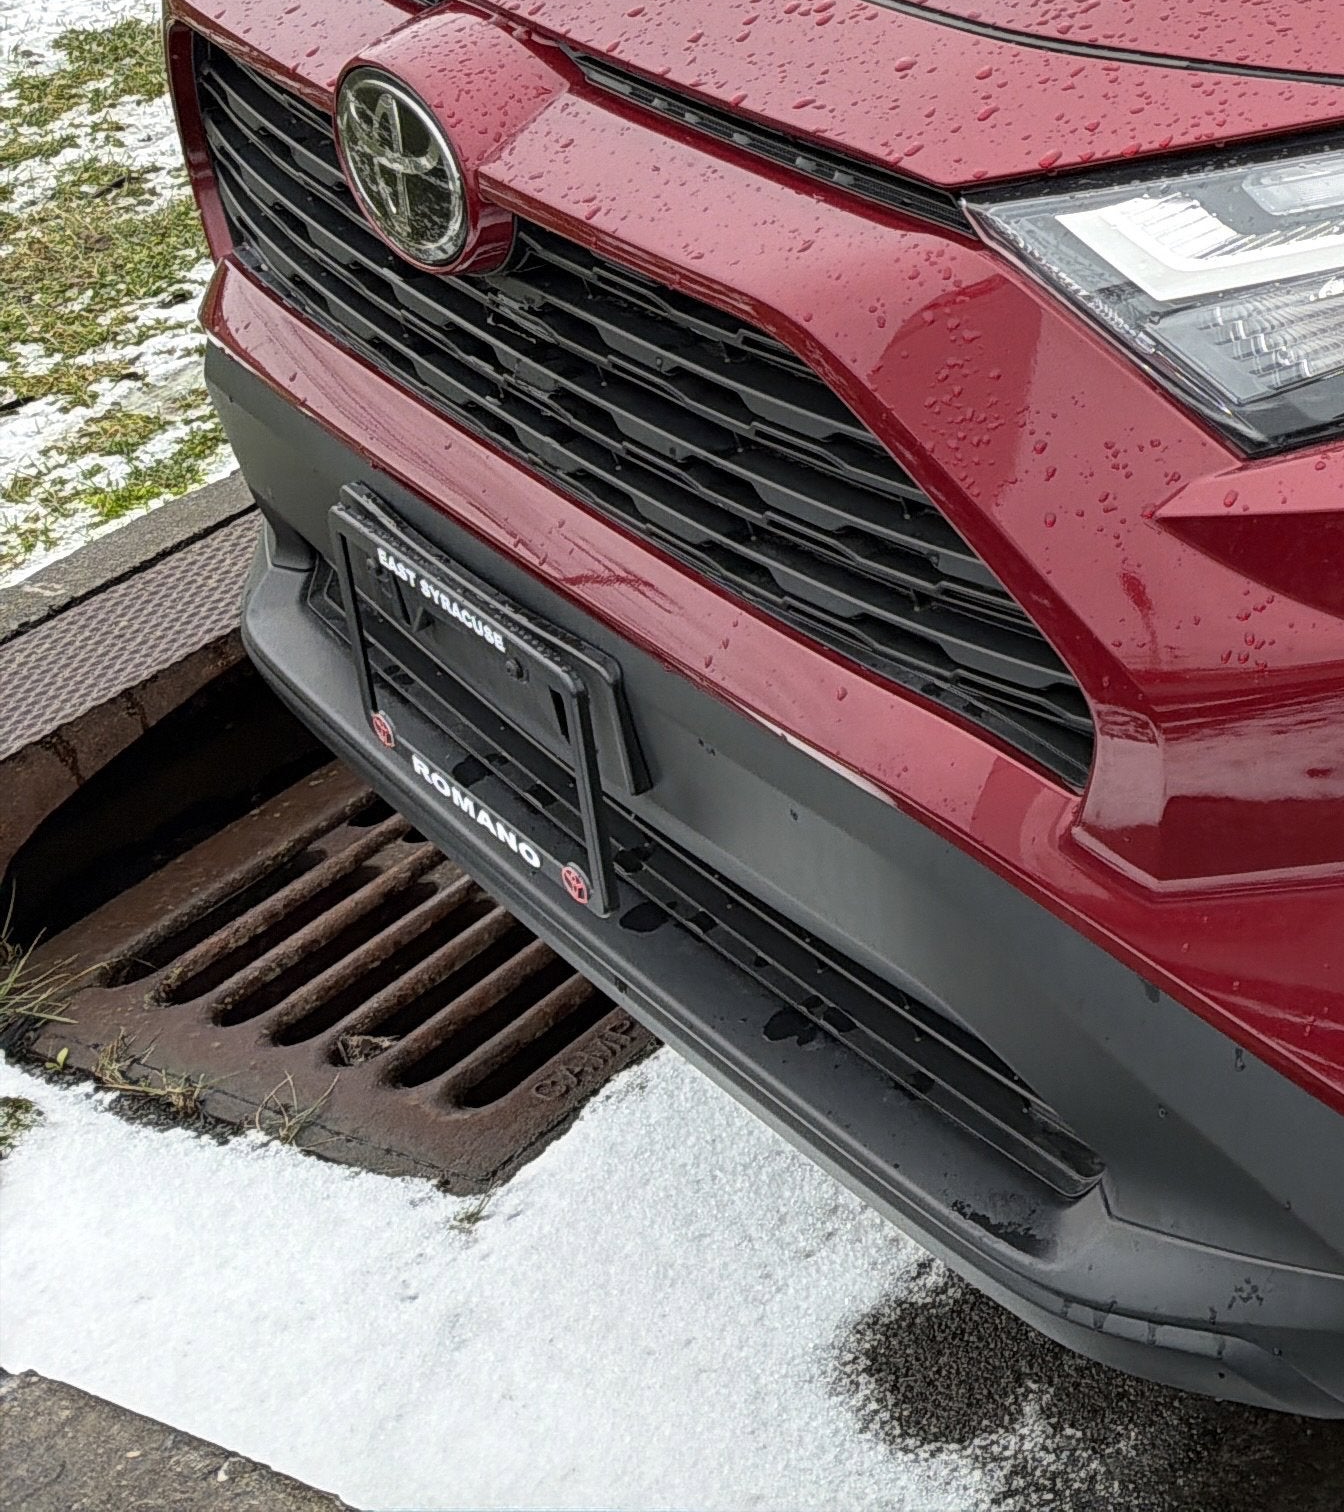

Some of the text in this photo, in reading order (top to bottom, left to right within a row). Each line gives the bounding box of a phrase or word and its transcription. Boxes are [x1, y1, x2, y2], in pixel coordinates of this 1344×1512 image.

[377, 547, 506, 653] EAST SYRACUSE
[411, 753, 541, 869] ROMANO
